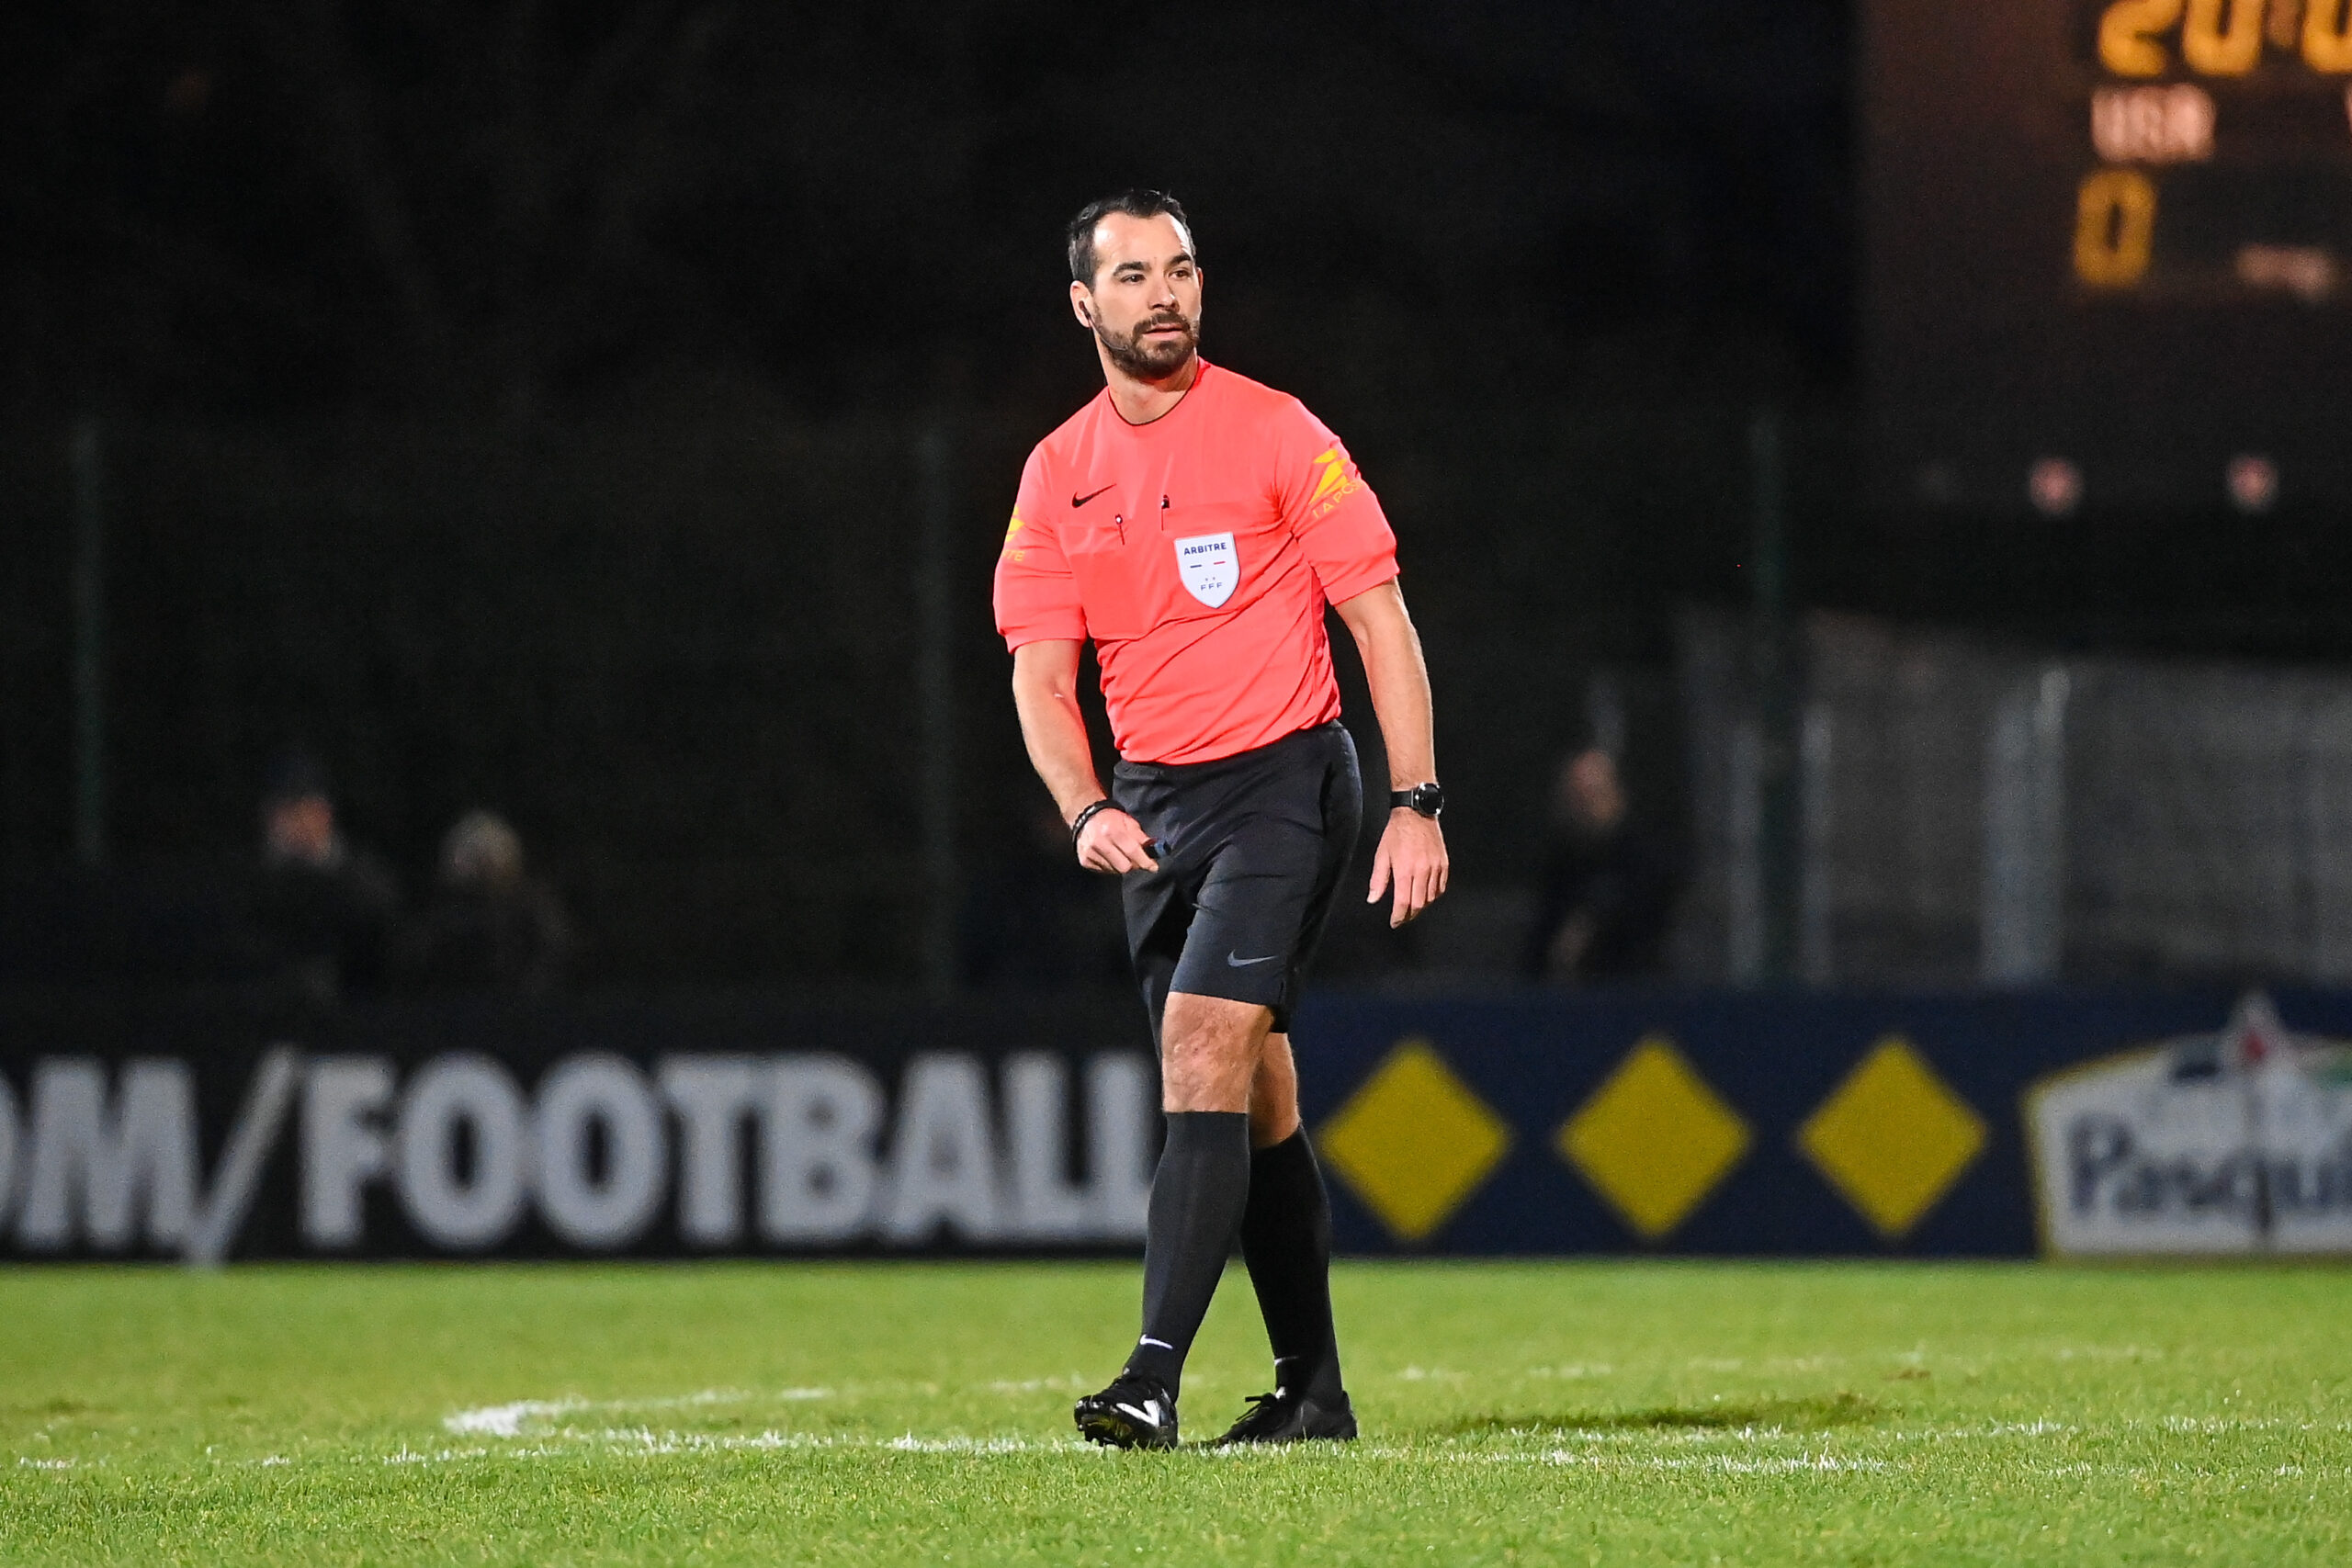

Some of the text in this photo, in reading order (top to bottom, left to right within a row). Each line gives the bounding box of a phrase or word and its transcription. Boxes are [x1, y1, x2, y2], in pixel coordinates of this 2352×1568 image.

[2073, 167, 2158, 288] 0
[1183, 542, 1227, 556] ARBITRE
[0, 1043, 1158, 1268] M/FOOTBALL
